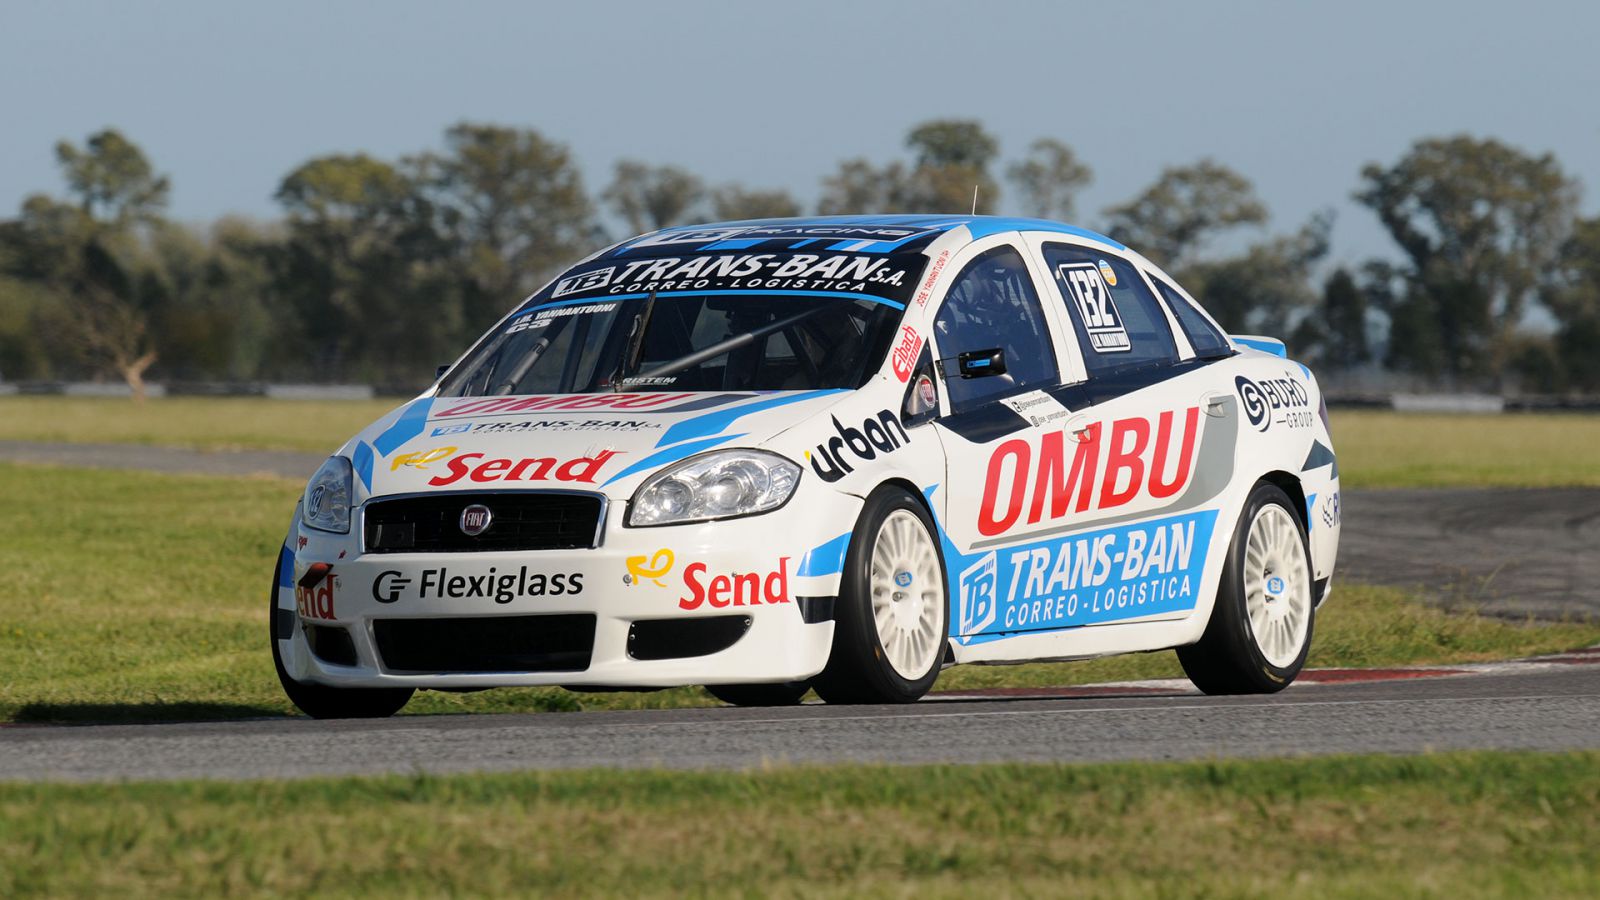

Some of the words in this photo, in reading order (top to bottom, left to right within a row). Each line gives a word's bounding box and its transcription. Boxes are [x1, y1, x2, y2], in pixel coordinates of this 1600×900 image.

[609, 278, 711, 294] CORREO
[730, 277, 866, 292] LOGISTICA
[611, 254, 888, 284] TRANS-BAN
[1068, 269, 1115, 327] 132
[892, 325, 917, 383] Eibach
[473, 420, 649, 431] TRANS-BAN
[1286, 411, 1313, 428] GROUP
[428, 450, 629, 487] Send
[810, 409, 911, 483] urban
[977, 406, 1200, 537] OMBU
[465, 512, 486, 527] FIAT
[679, 557, 792, 611] Send
[1006, 520, 1196, 602] TRANS-BAN
[419, 565, 584, 605] Flexiglass
[1005, 595, 1077, 628] CORREO
[1092, 574, 1192, 613] LOGISTICA
